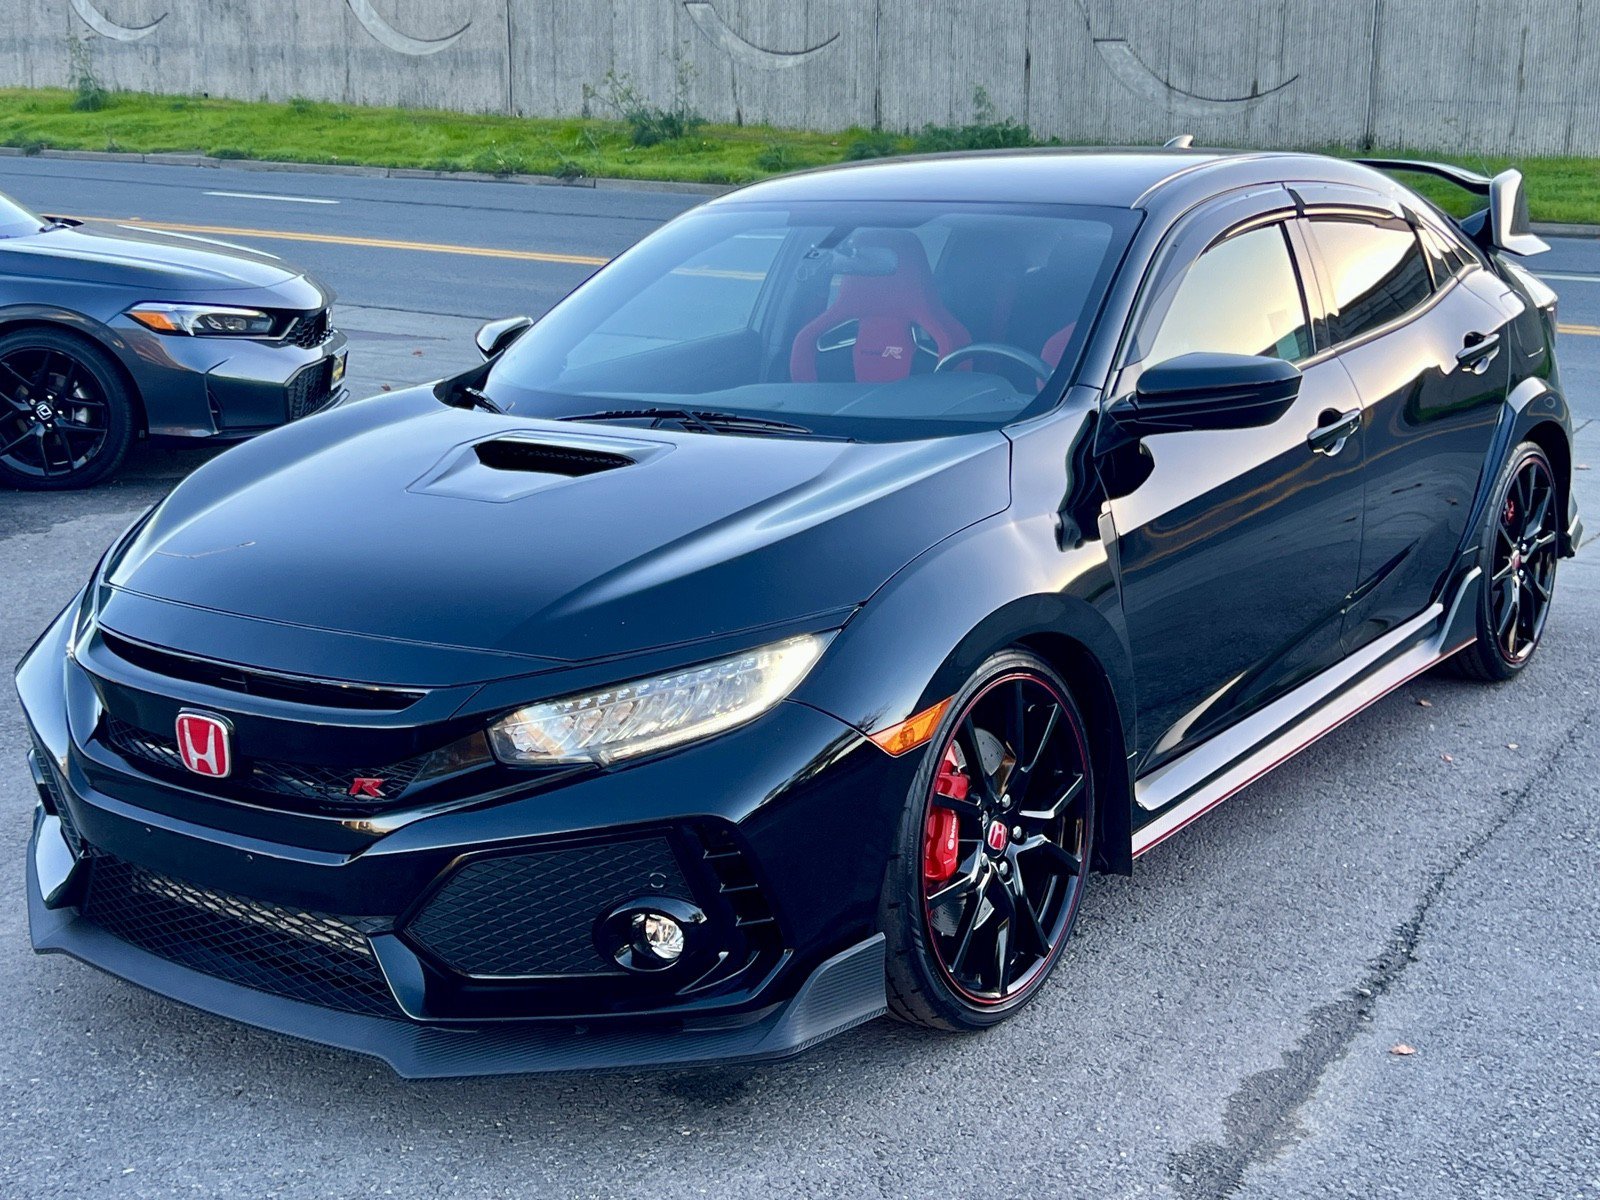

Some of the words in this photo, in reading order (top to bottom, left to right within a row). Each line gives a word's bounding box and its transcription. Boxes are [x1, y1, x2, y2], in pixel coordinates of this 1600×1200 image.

[882, 346, 903, 360] R
[183, 719, 219, 775] H
[349, 777, 386, 797] R
